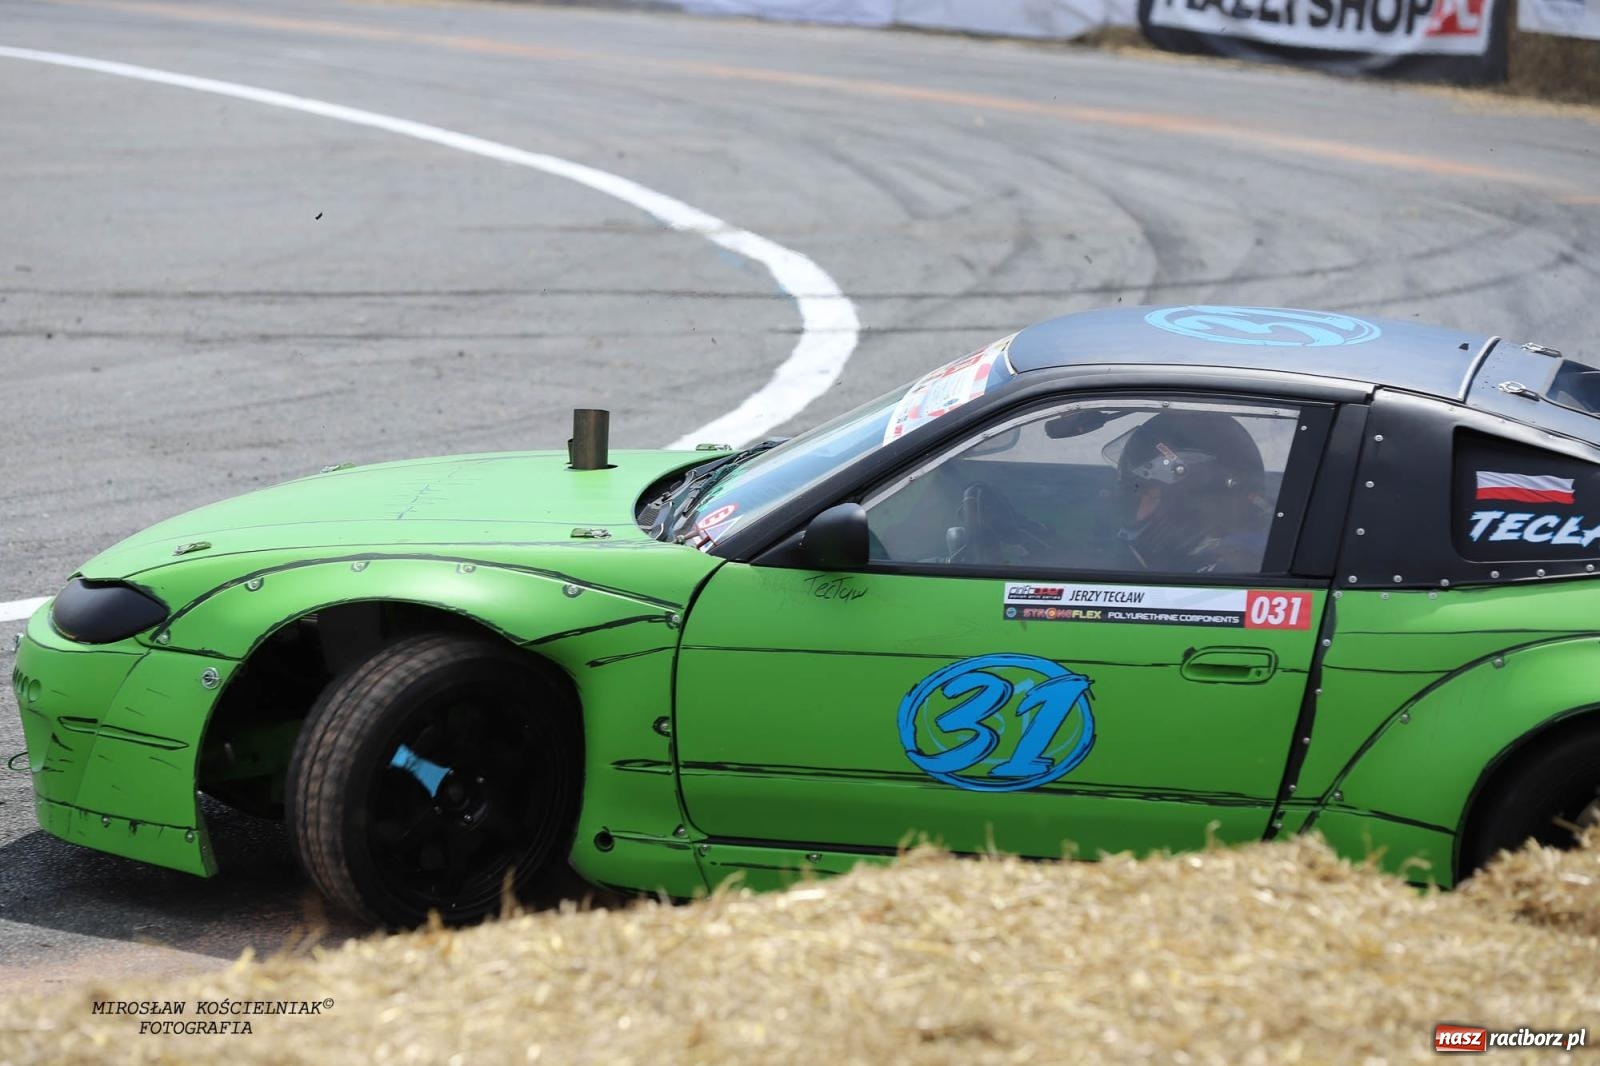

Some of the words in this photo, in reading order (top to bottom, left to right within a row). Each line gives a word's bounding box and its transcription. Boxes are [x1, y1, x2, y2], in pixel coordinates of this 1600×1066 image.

[1069, 589, 1101, 602] JERZY
[1102, 591, 1145, 603] TECŁAW
[1107, 611, 1179, 622] POLYURETHANE
[1180, 614, 1240, 624] COMPONENTS
[1250, 596, 1302, 625] 031
[906, 670, 1095, 777] 31
